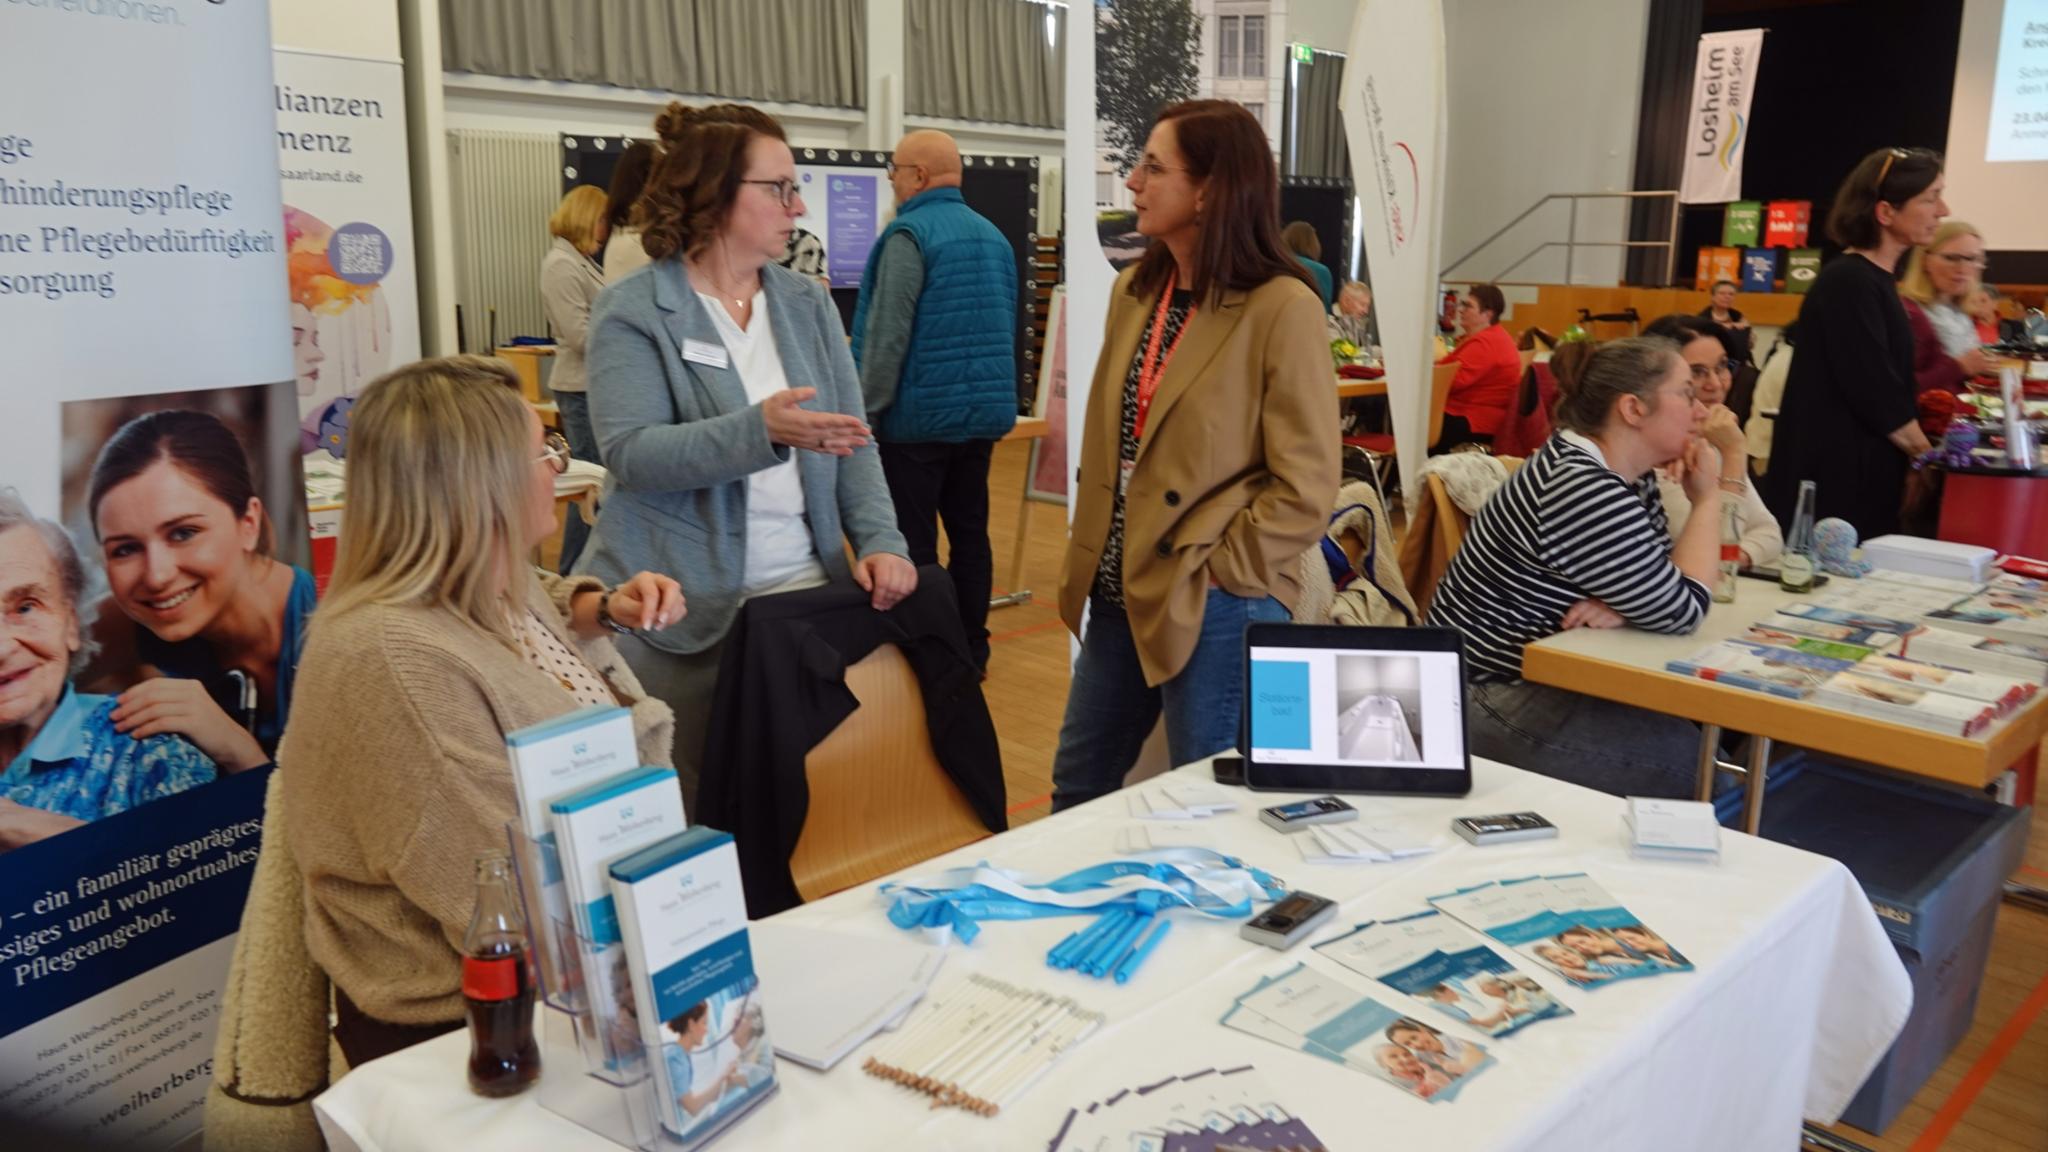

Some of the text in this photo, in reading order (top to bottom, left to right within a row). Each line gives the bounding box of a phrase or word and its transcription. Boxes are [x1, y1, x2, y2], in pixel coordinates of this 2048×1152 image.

[1727, 46, 1744, 106] am See
[274, 84, 383, 119] lianzen
[1696, 47, 1726, 157] Losheim
[0, 135, 33, 164] ge
[0, 178, 233, 216] hinderungspflege
[0, 233, 31, 253] ne
[40, 226, 275, 260] Pflegebedürftigkeit
[0, 270, 115, 299] sorgung
[32, 891, 70, 915] ein
[76, 853, 162, 899] familiär
[68, 898, 112, 933] und
[117, 846, 261, 912] wohnortnahes
[14, 906, 177, 987] Pflegeangebot.
